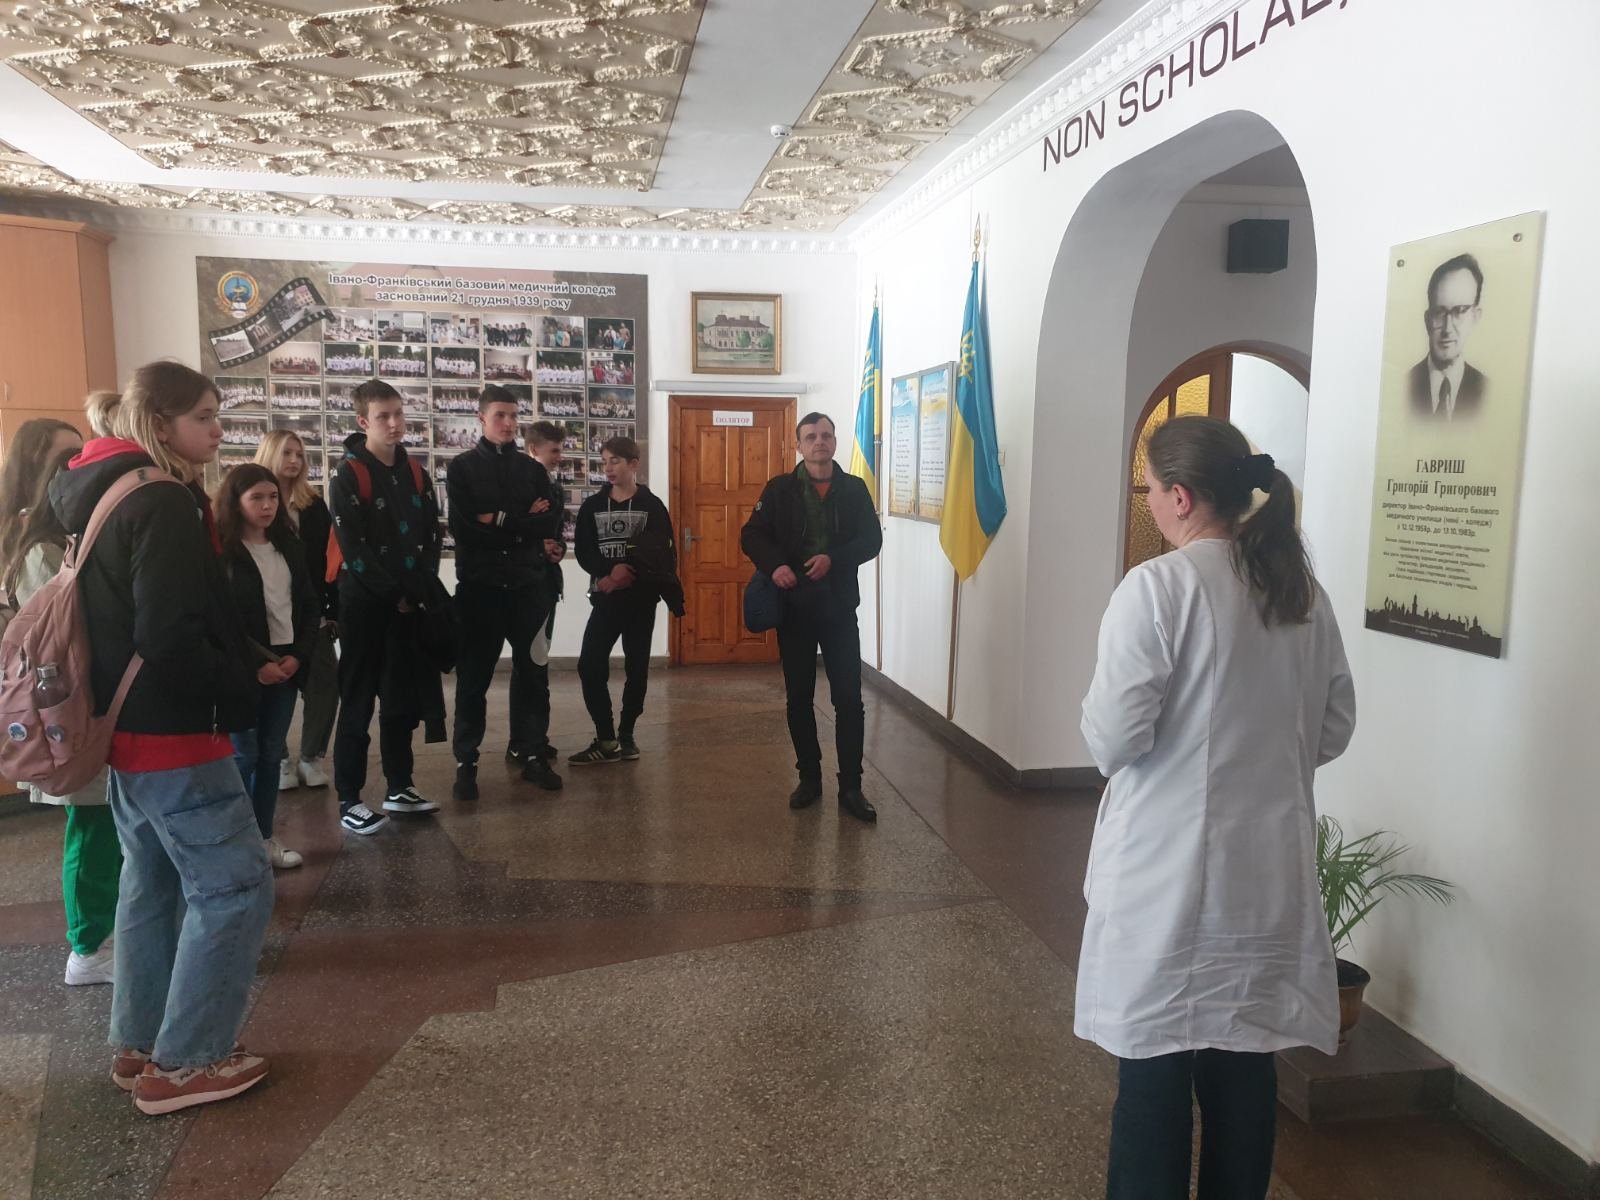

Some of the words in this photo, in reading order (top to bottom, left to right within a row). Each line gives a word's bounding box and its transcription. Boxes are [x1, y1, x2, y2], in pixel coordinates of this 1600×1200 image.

[1043, 100, 1106, 172] NON
[328, 273, 452, 288] Івано-Франківський
[455, 278, 506, 290] базовий
[509, 281, 569, 293] медичний
[572, 284, 616, 296] коледж
[377, 291, 448, 302] заснований
[452, 293, 465, 303] 21
[468, 295, 510, 306] грудня
[514, 295, 540, 306] 1939
[543, 298, 572, 311] року
[1416, 459, 1465, 474] ГАВРИШ
[1387, 478, 1429, 496] Григорій
[1434, 480, 1497, 499] Григорович
